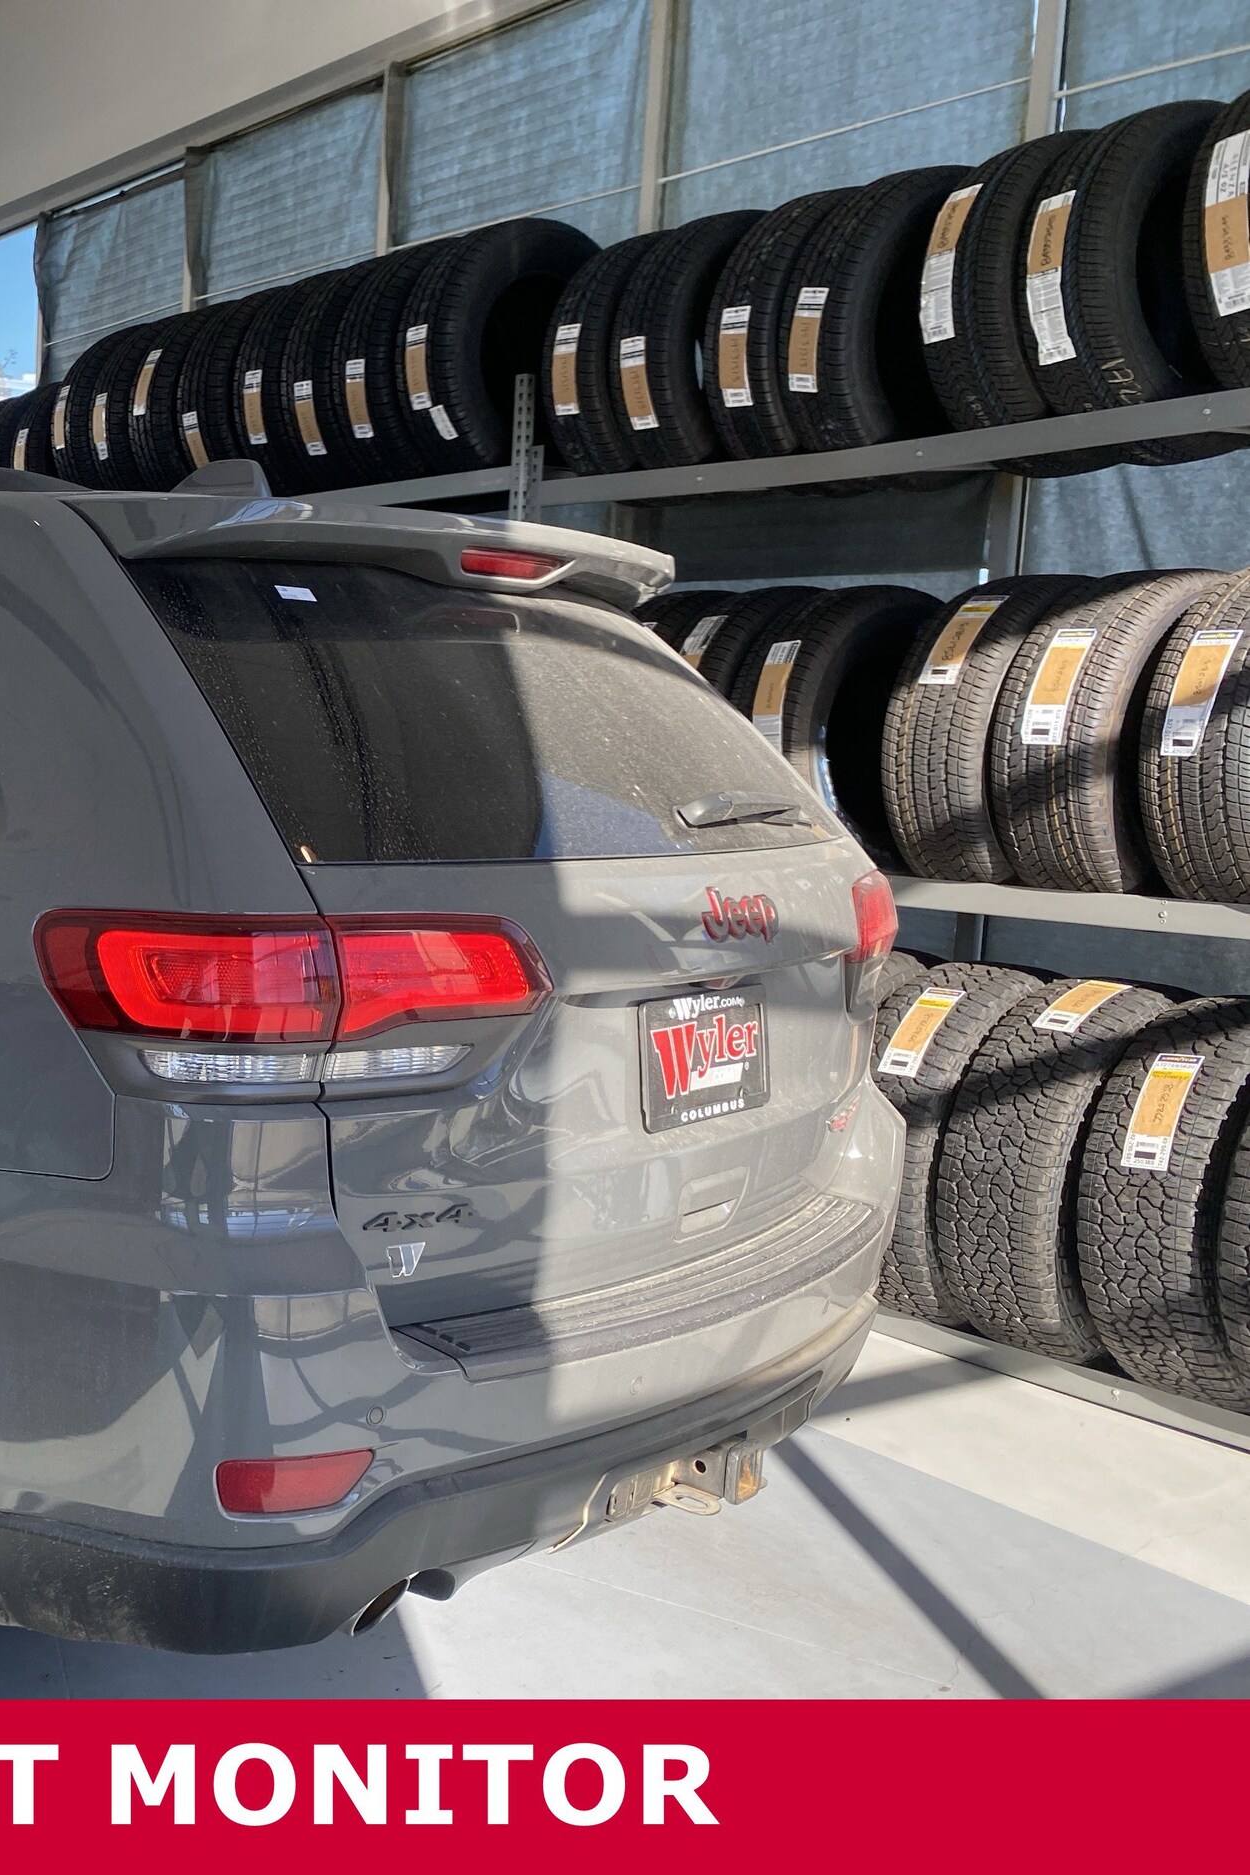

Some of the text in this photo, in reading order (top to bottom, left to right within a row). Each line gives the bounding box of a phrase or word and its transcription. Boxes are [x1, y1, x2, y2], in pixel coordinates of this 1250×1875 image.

[701, 886, 779, 946] Jeep
[650, 1014, 758, 1100] Wyler
[681, 1099, 745, 1122] COLUMBUS
[362, 1203, 473, 1232] 4x4
